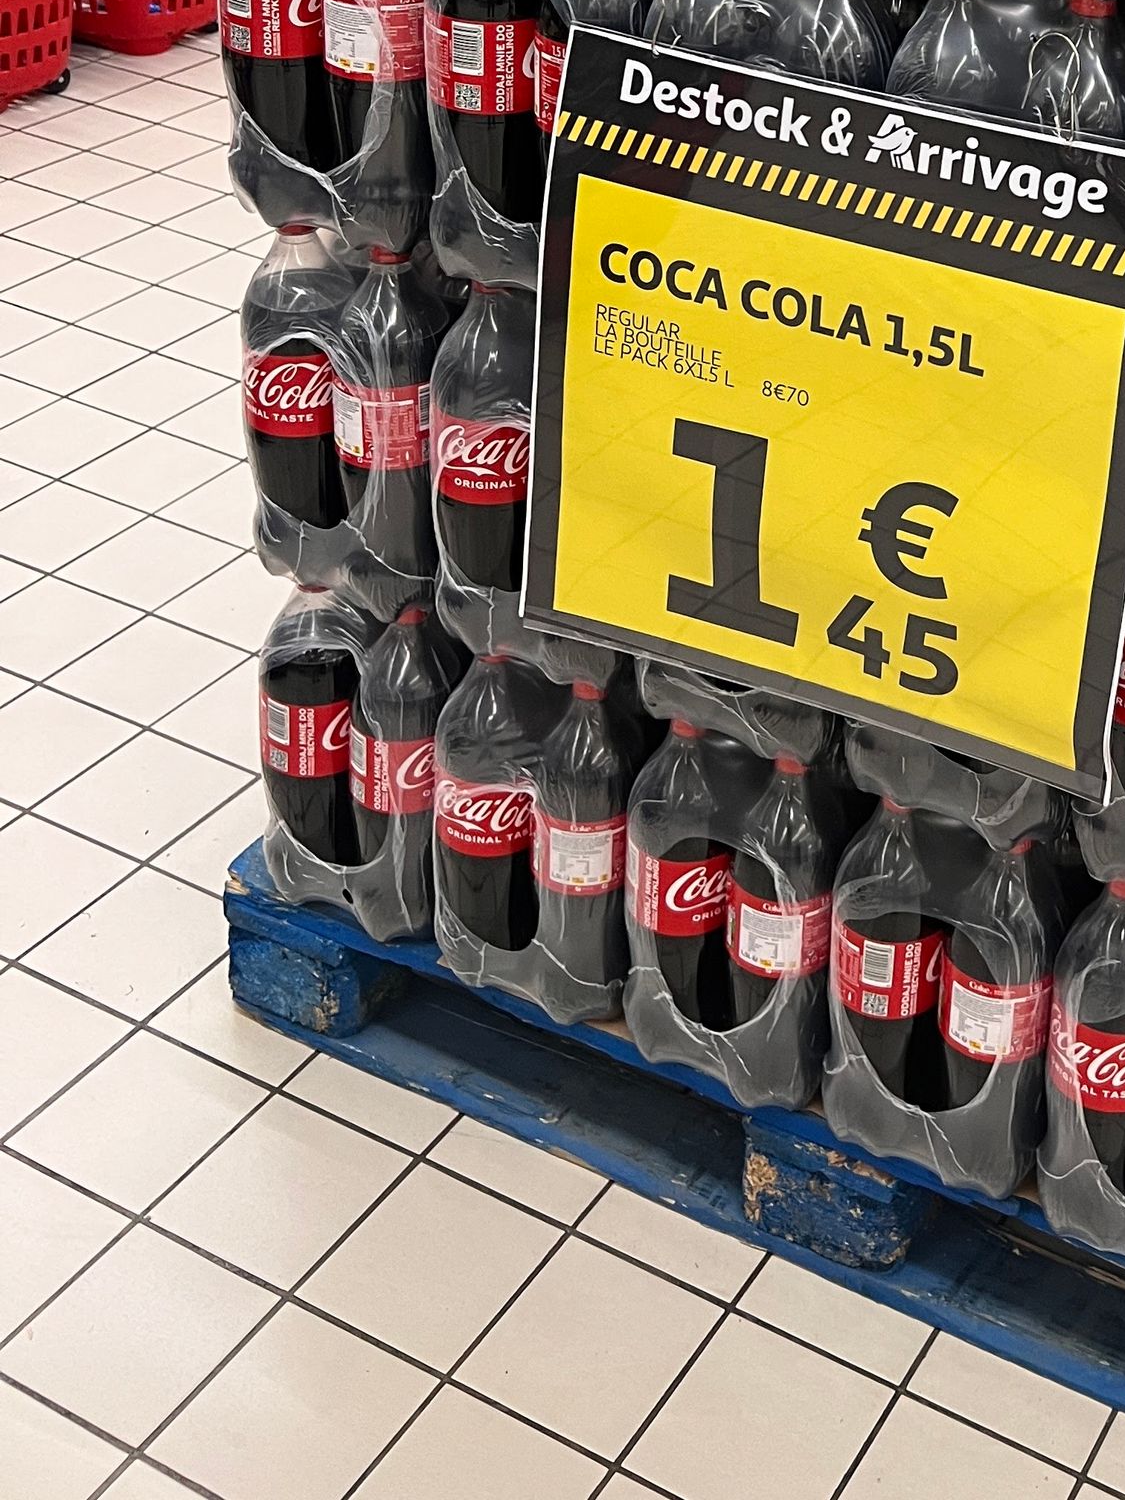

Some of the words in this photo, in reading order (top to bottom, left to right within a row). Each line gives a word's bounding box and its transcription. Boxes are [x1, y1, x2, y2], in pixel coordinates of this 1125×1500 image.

[263, 19, 272, 56] ODDAJ
[496, 25, 505, 41] DO
[496, 43, 505, 73] MNIE
[505, 25, 514, 86] RECYKLINGU
[496, 75, 505, 112] ODDAJ
[619, 58, 811, 149] Destock
[821, 107, 854, 157] &
[866, 114, 1109, 220] Arrivage
[596, 303, 680, 340] REGULAR
[598, 242, 728, 312] COCA
[741, 279, 871, 348] COLA
[884, 313, 985, 378] 1,5L
[595, 320, 617, 340] LA
[623, 331, 722, 368] BOUTEILLE
[594, 336, 615, 357] LE
[620, 342, 668, 371] PACK
[725, 370, 735, 388] L
[762, 380, 810, 407] 8€70
[273, 413, 314, 423] TASTE
[454, 477, 516, 490] ORIGINAL
[665, 417, 799, 647] 1
[857, 481, 959, 600] €
[826, 593, 960, 696] 45
[447, 826, 502, 844] ORIGINAL
